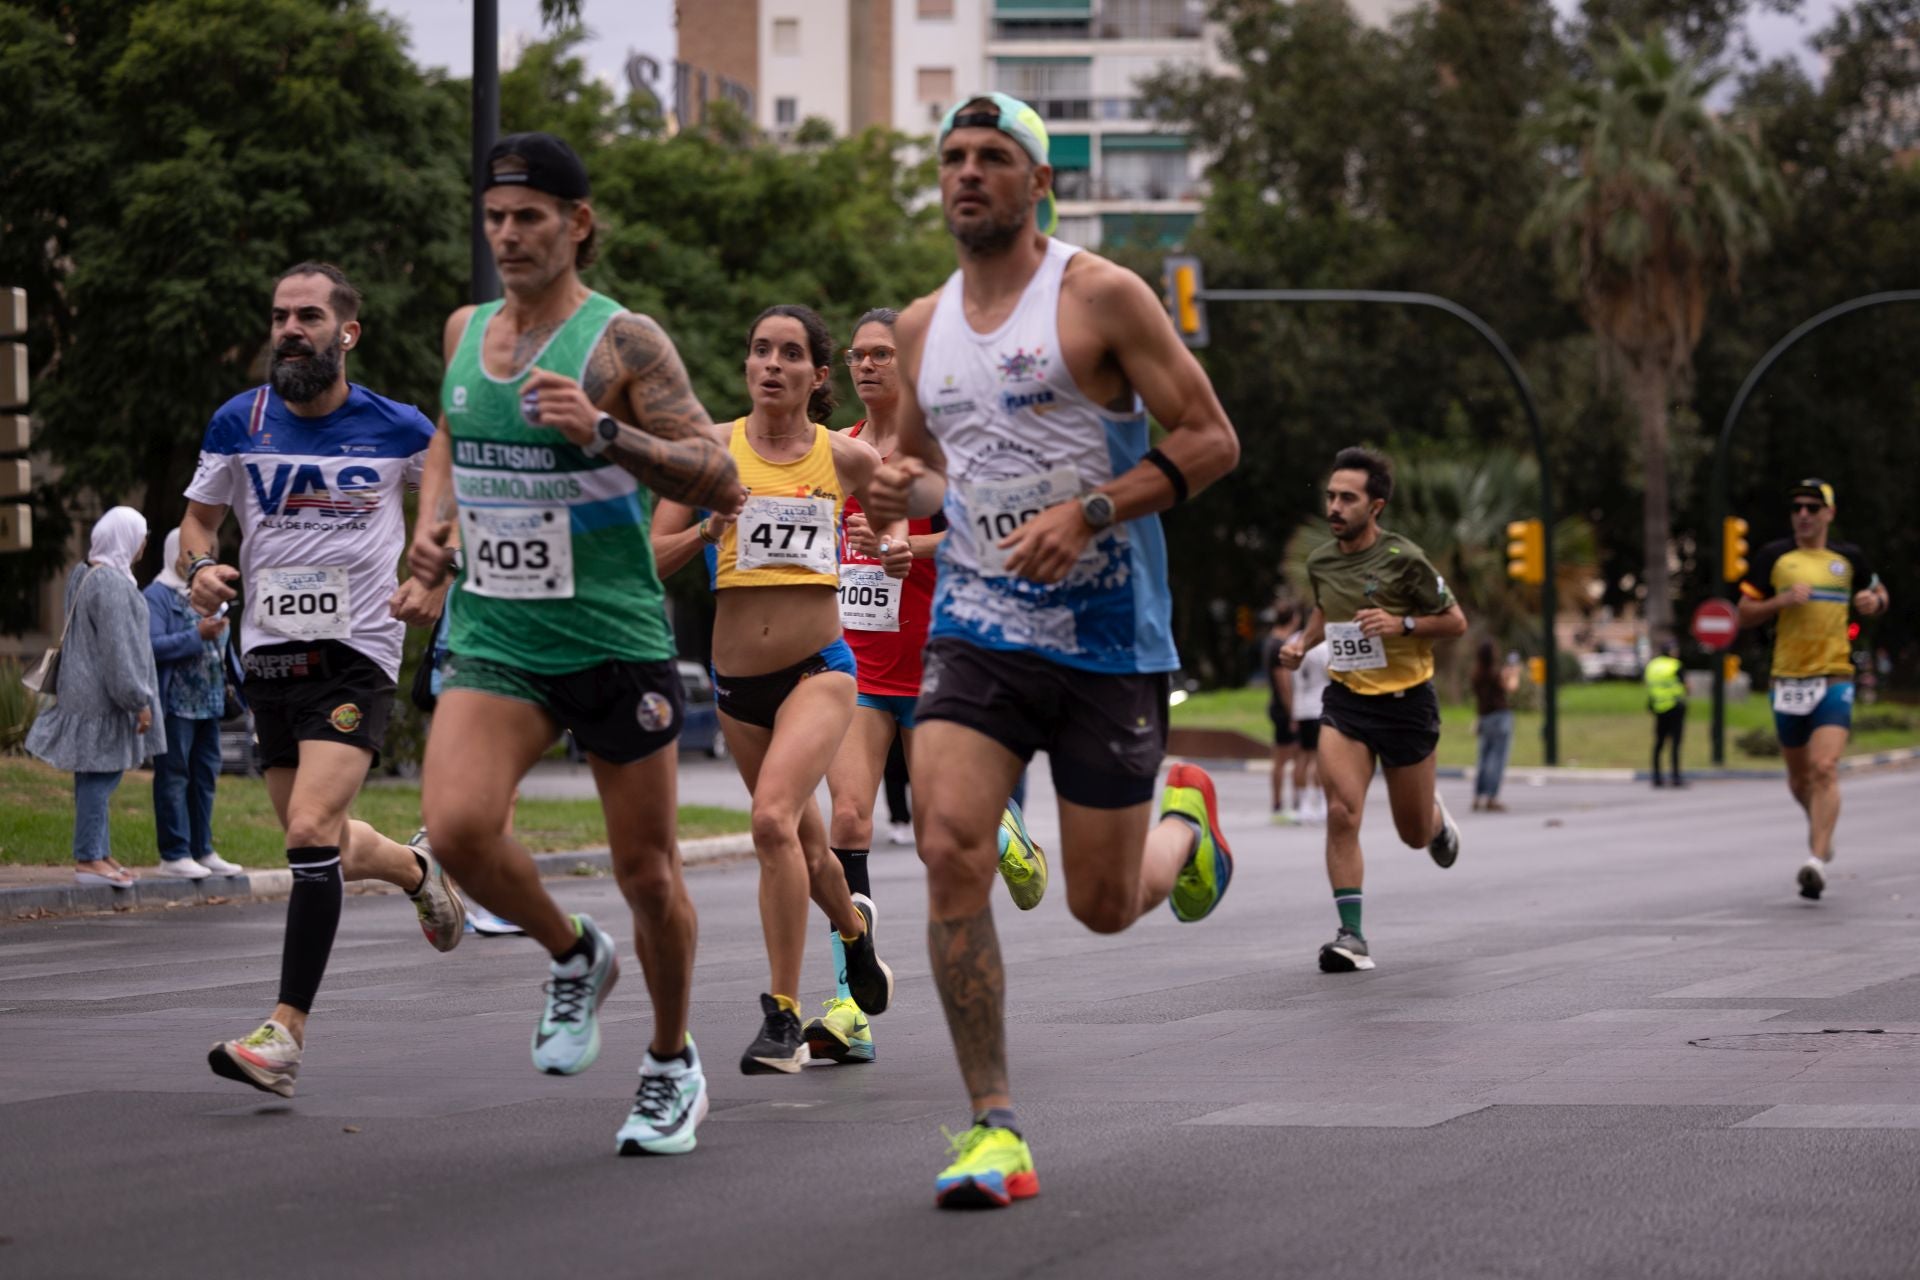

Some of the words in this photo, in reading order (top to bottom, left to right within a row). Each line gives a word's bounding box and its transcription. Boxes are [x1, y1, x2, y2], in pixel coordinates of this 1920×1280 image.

[457, 441, 556, 470] ATLETISMO
[244, 463, 382, 518] VAS
[750, 523, 819, 550] 477
[478, 539, 550, 570] 403
[262, 592, 339, 616] 1200
[839, 586, 889, 607] 1005
[1332, 638, 1373, 657] 596
